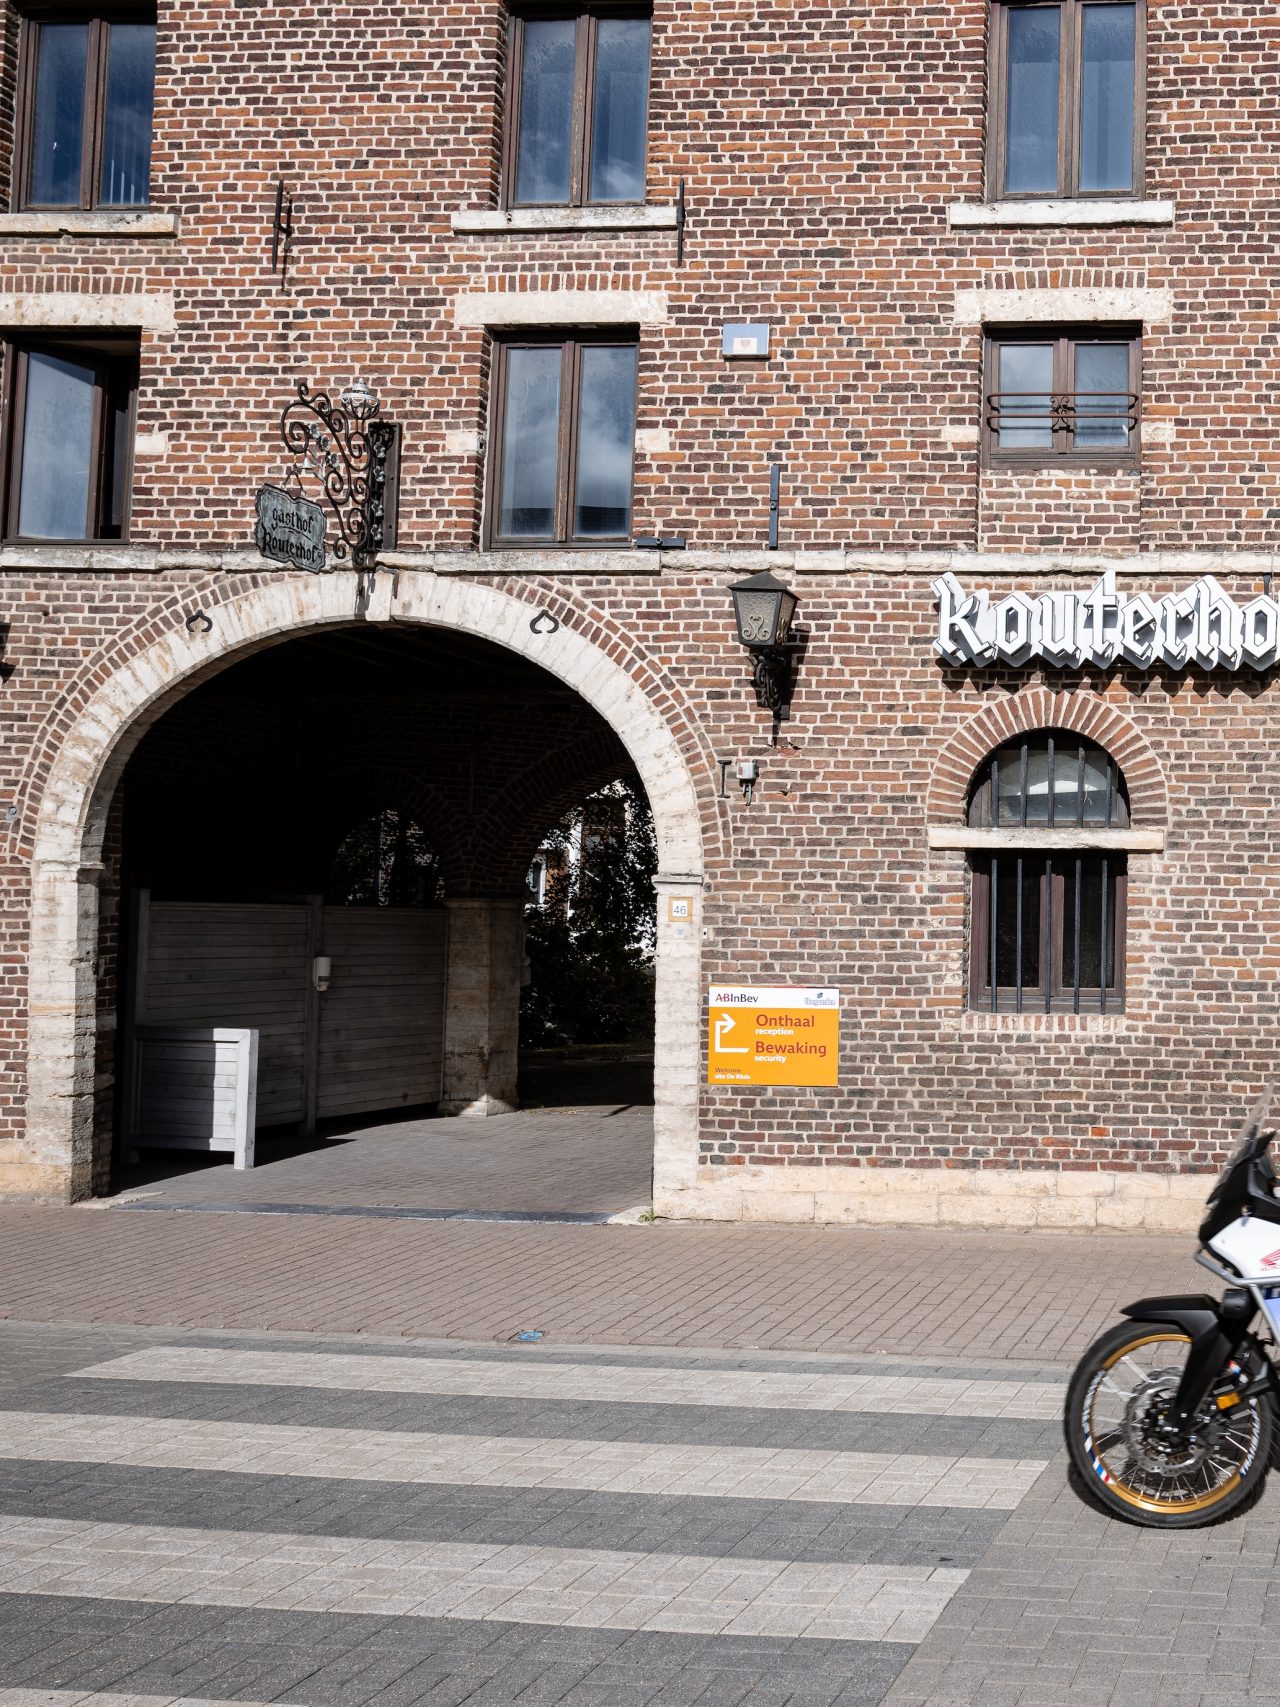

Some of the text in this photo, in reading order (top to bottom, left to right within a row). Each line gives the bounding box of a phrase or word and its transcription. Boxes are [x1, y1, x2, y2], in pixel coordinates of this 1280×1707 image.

[673, 905, 687, 915] 46
[756, 1014, 815, 1028] Onthaal
[755, 1028, 794, 1036] reception
[755, 1041, 827, 1057] Bewaking
[754, 1055, 787, 1063] security
